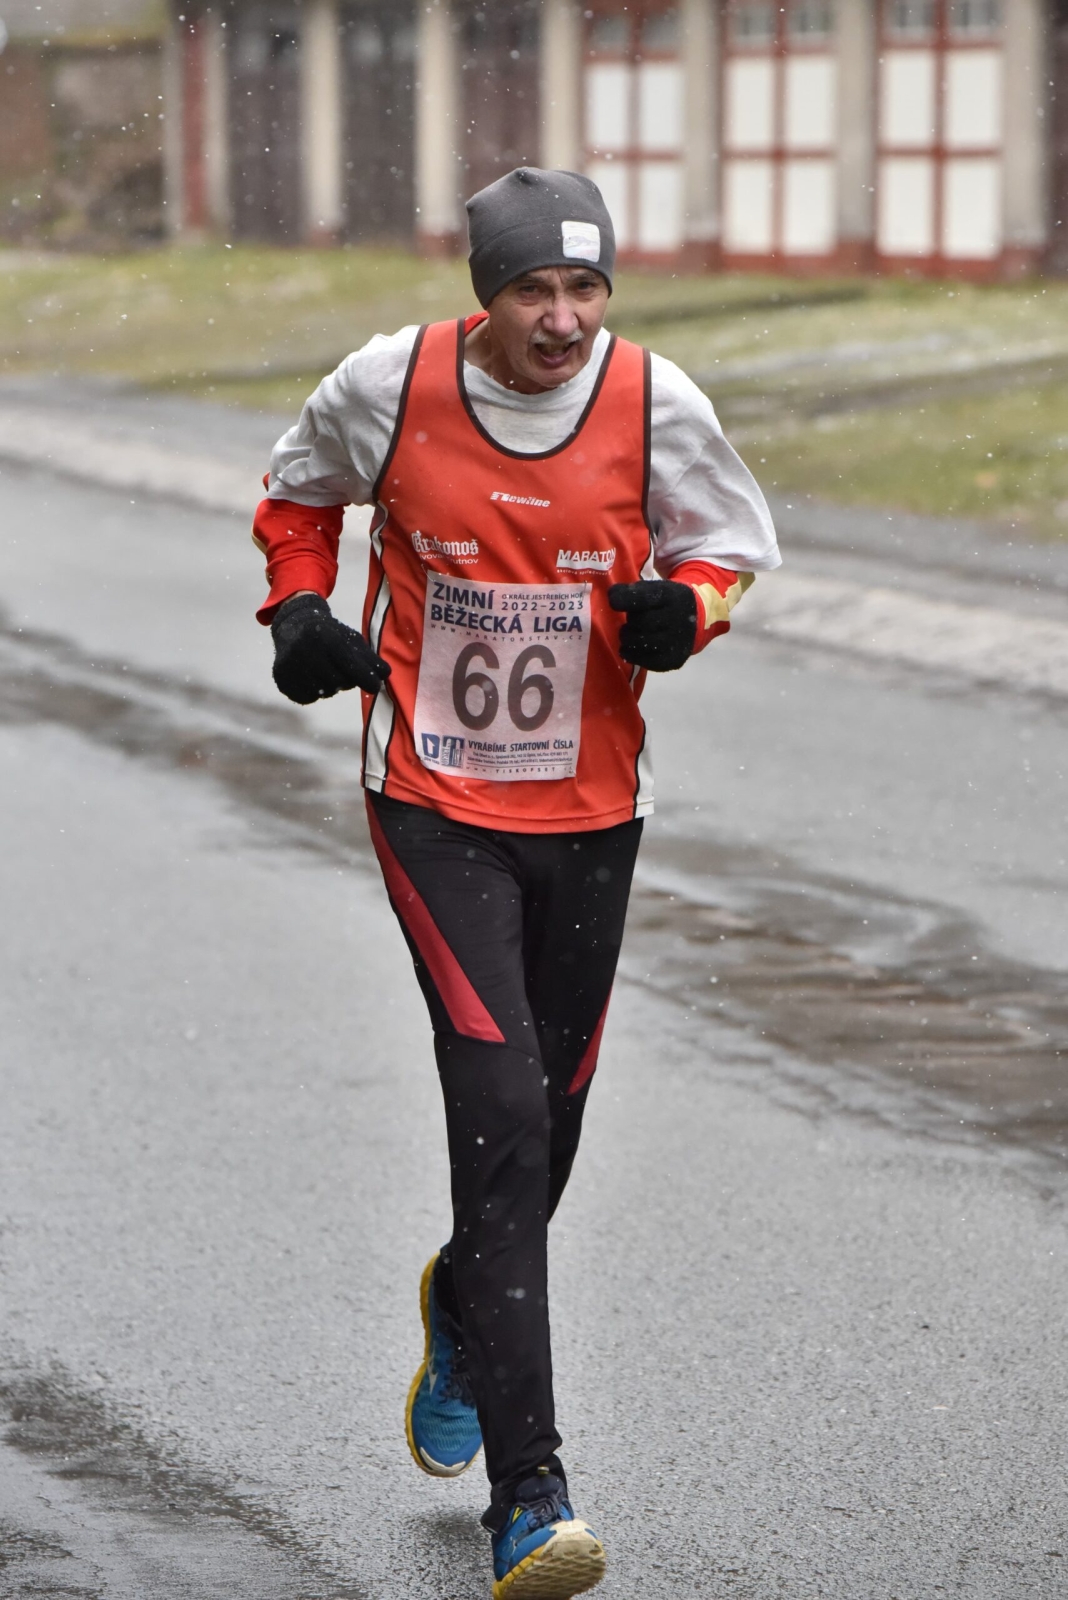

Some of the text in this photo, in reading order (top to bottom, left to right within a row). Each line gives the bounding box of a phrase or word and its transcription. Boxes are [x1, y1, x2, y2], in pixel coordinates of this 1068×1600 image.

[411, 530, 479, 555] Krakonoš
[557, 547, 617, 563] MARATON
[432, 581, 496, 610] ZIMNÍ
[508, 592, 530, 600] KRÁLE
[430, 604, 583, 634] BĚŽECKÁ LIGA
[452, 641, 557, 732] 66
[468, 738, 574, 752] VYRÁBÍME STARTOVNÍ ČÍSLA
